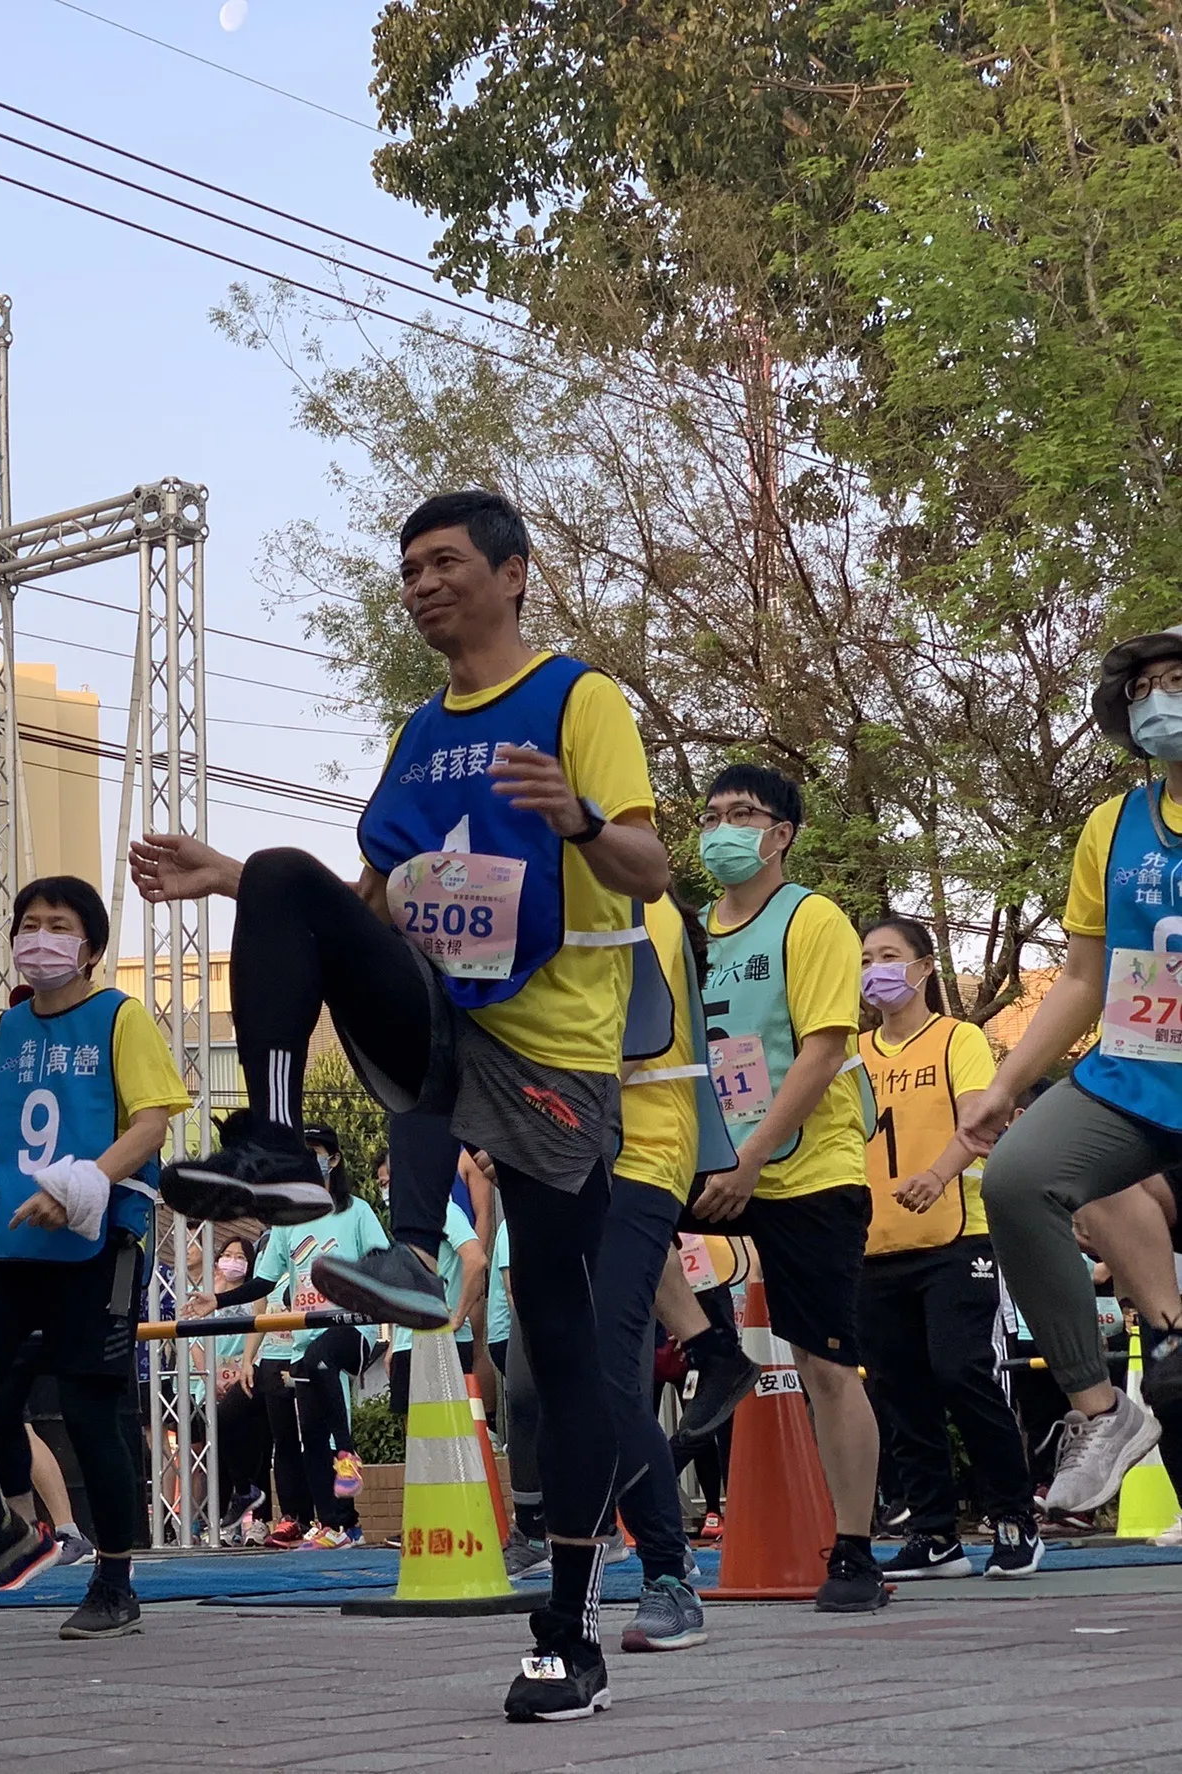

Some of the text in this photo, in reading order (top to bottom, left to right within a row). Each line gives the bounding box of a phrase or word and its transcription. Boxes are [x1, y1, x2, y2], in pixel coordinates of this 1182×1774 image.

[430, 740, 538, 783] 客家委員
[1135, 852, 1168, 905] 先鋒堆
[404, 901, 493, 938] 2508
[719, 954, 771, 987] 六龜
[1129, 995, 1182, 1025] 27
[18, 1040, 37, 1084] 先鋒堆
[46, 1044, 99, 1076] 萬巒
[886, 1065, 936, 1094] 竹田
[18, 1089, 59, 1176] 9
[878, 1106, 898, 1179] 1
